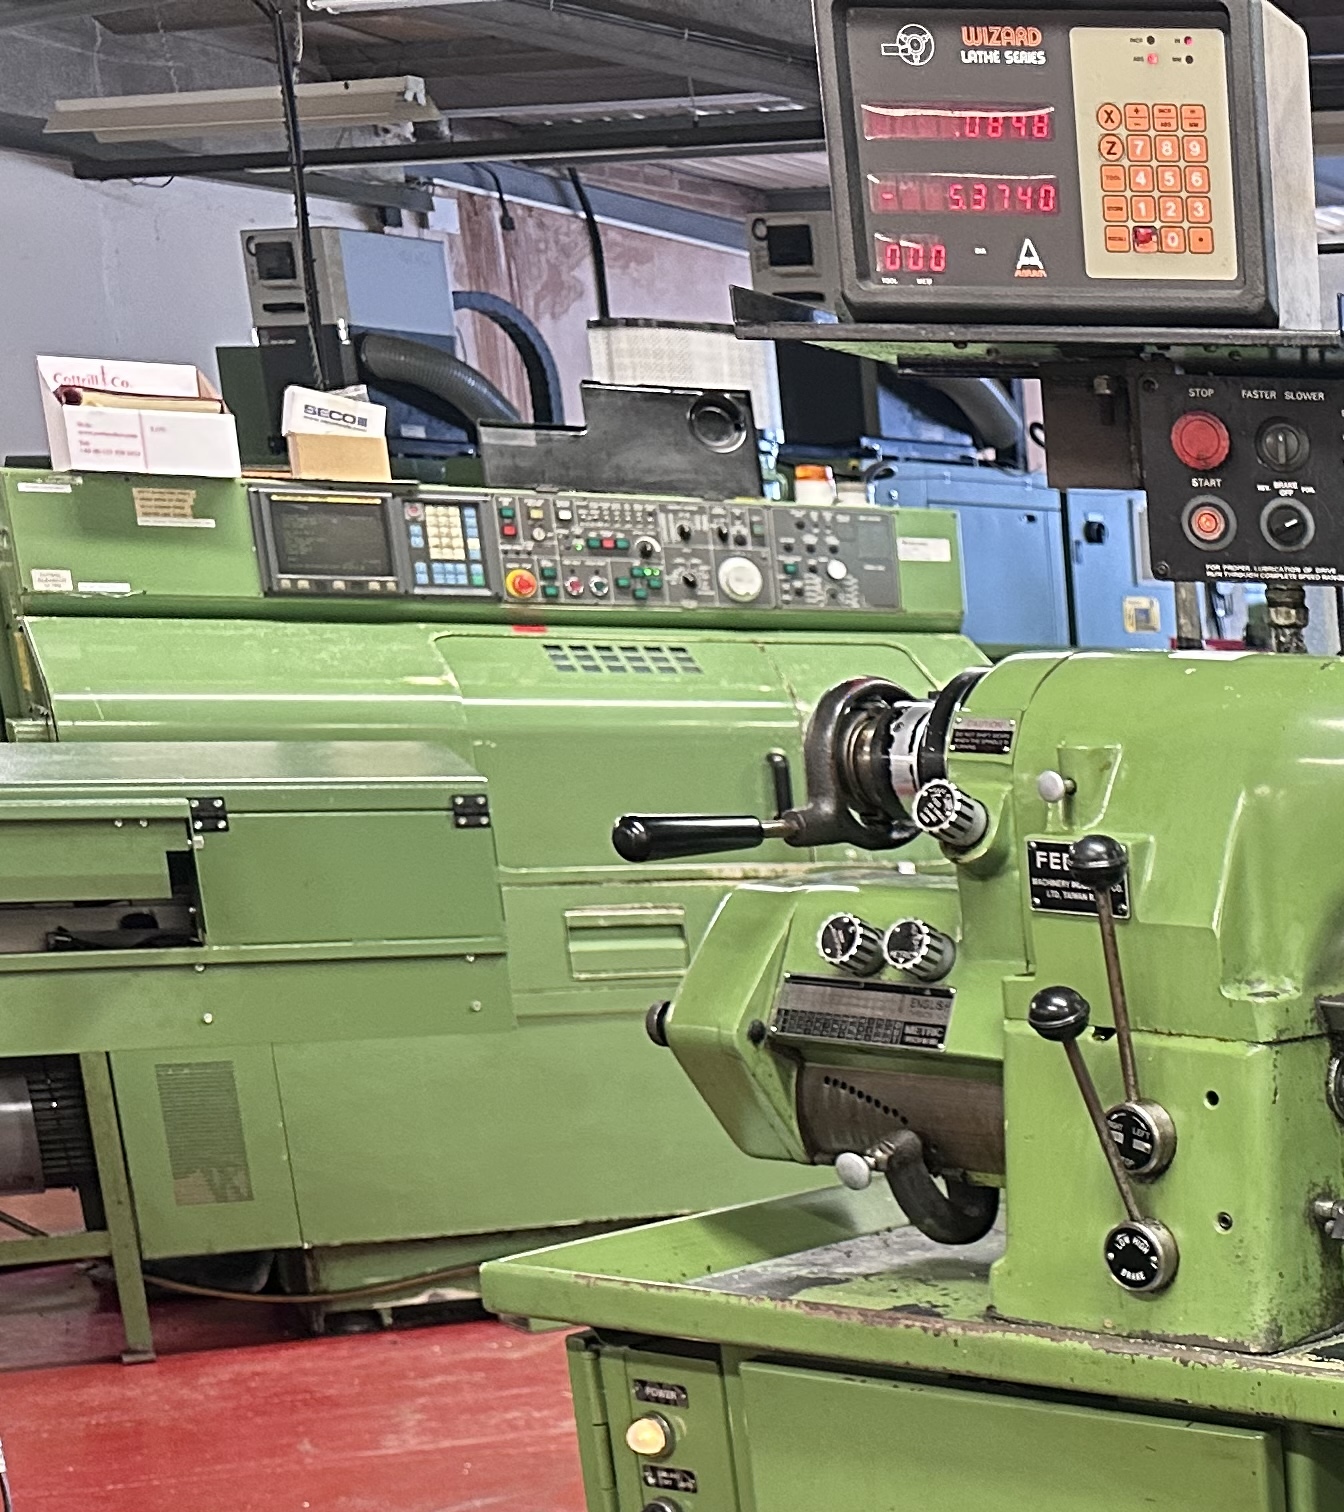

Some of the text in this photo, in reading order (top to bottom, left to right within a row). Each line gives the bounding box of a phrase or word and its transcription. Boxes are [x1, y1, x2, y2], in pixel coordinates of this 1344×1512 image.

[961, 26, 1042, 47] WIZARD
[960, 50, 1046, 65] LATHE SERIES
[1103, 109, 1115, 124] X
[1105, 140, 1118, 156] Z
[1133, 140, 1145, 156] 7
[1161, 140, 1173, 156] 8
[1188, 140, 1201, 156] 9
[1135, 171, 1147, 186] 4
[1163, 171, 1175, 187] 5
[1191, 171, 1203, 187] 6
[1137, 201, 1147, 217] 1
[1165, 201, 1177, 217] 2
[1193, 201, 1205, 217] 3
[1167, 231, 1179, 247] 0
[1188, 387, 1215, 398] STOP
[1241, 389, 1326, 400] FASTER SLOWER
[303, 404, 357, 425] SECO
[1191, 477, 1222, 488] START
[644, 1385, 678, 1400] POWER
